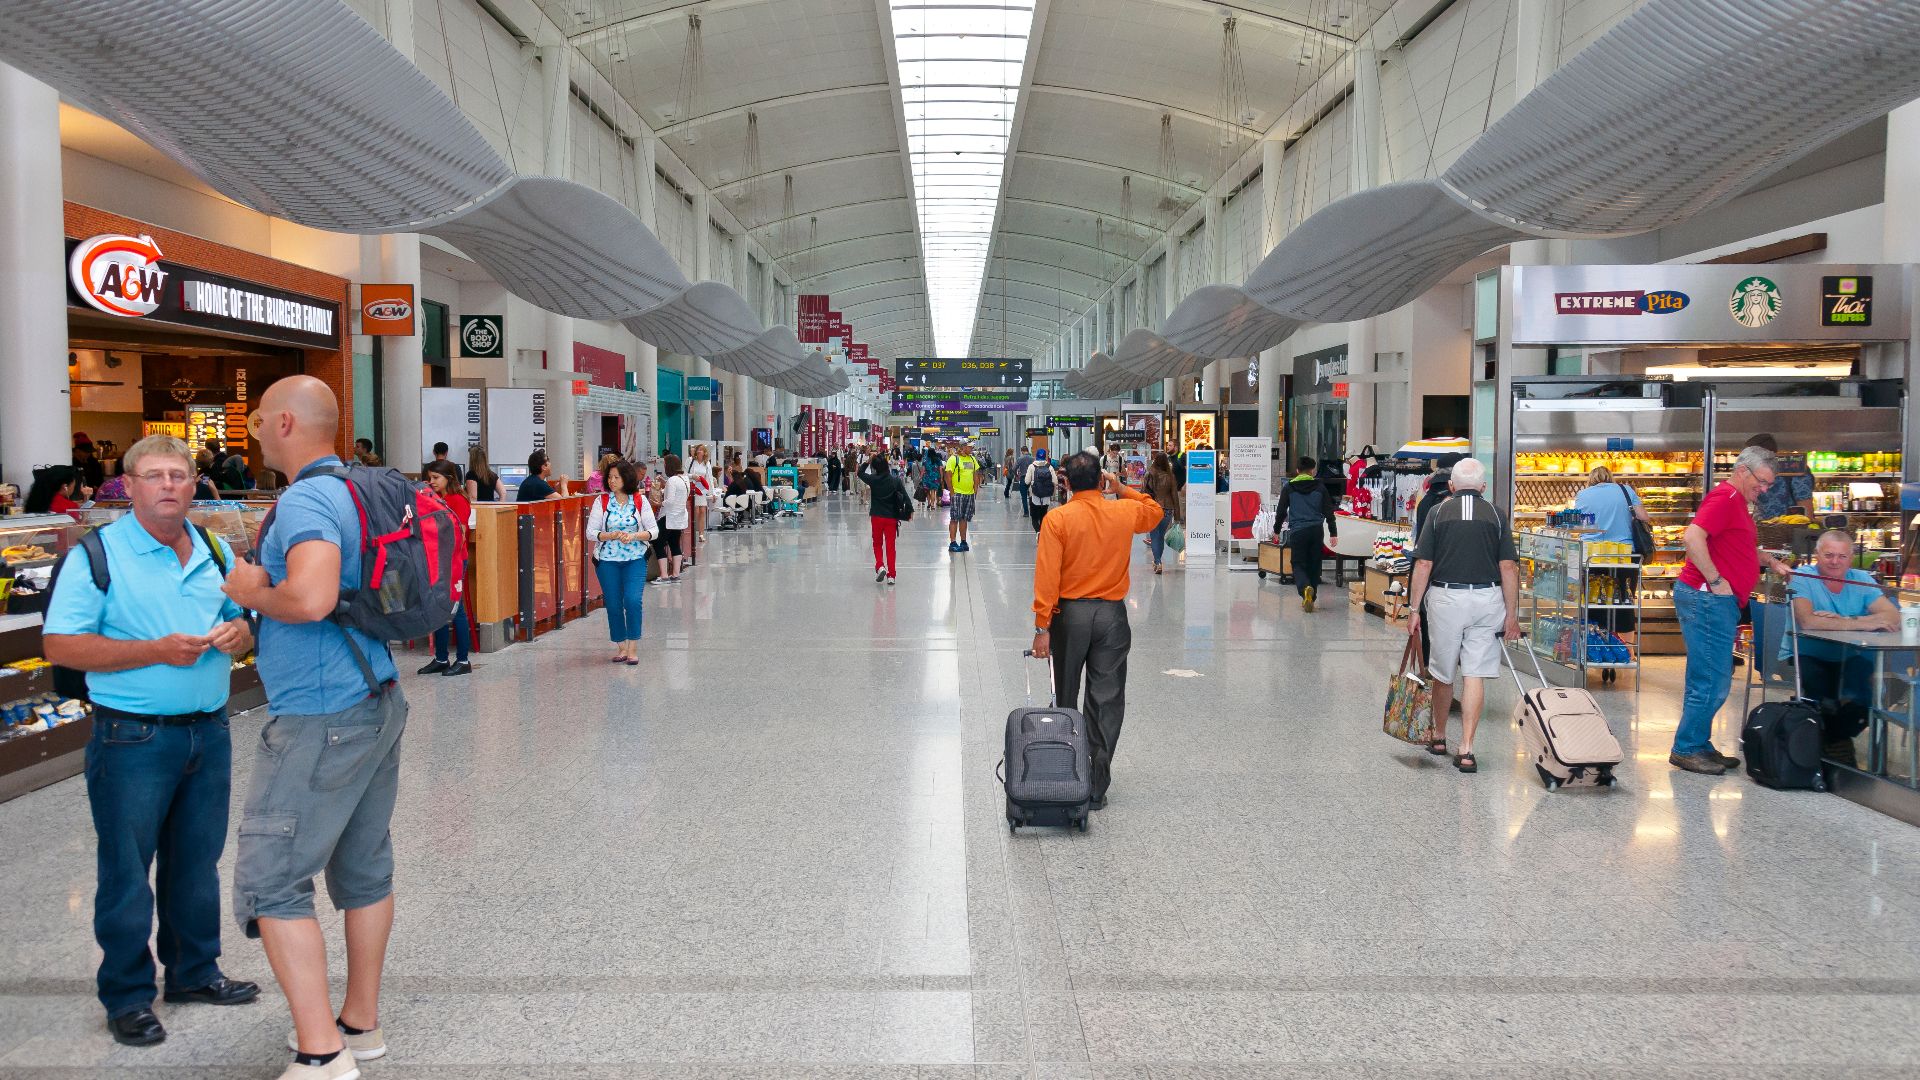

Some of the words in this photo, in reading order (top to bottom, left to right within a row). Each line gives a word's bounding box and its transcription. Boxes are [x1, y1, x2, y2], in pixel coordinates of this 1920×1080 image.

[95, 261, 169, 304] A&W
[196, 281, 229, 317] HOME
[229, 288, 243, 320] OF
[245, 292, 265, 323] THE
[266, 296, 302, 330] BURGER
[303, 305, 333, 336] FAMILY
[371, 306, 408, 317] A&W
[1560, 296, 1636, 309] EXTREME
[1646, 293, 1684, 312] Pita
[236, 368, 246, 381] ICE
[236, 381, 247, 401] COLD
[467, 392, 480, 424] ORDER
[532, 393, 546, 425] ORDER
[225, 402, 249, 450] ROOT
[468, 430, 480, 452] ELF
[1190, 531, 1211, 539] iStore
